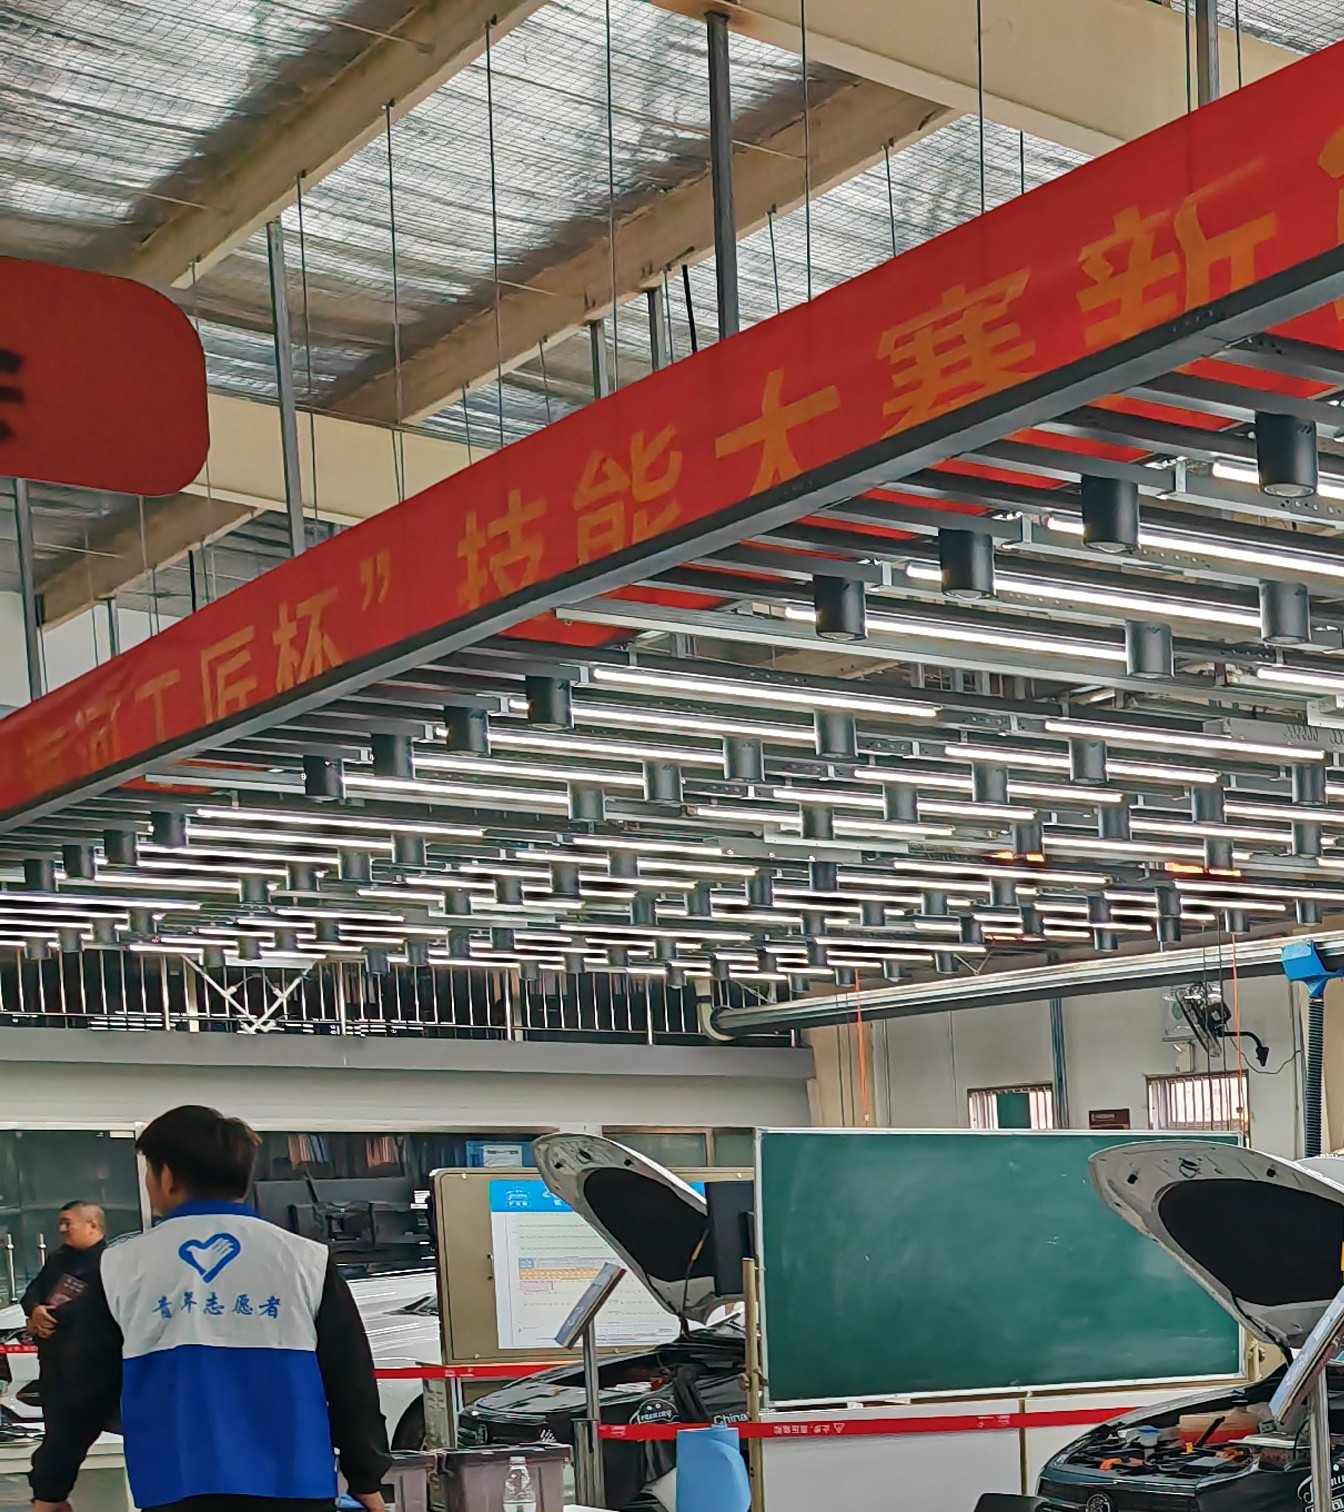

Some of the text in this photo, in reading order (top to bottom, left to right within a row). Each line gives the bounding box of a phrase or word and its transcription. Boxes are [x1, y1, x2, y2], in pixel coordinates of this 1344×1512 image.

[152, 1291, 281, 1319] 青年志愿者
